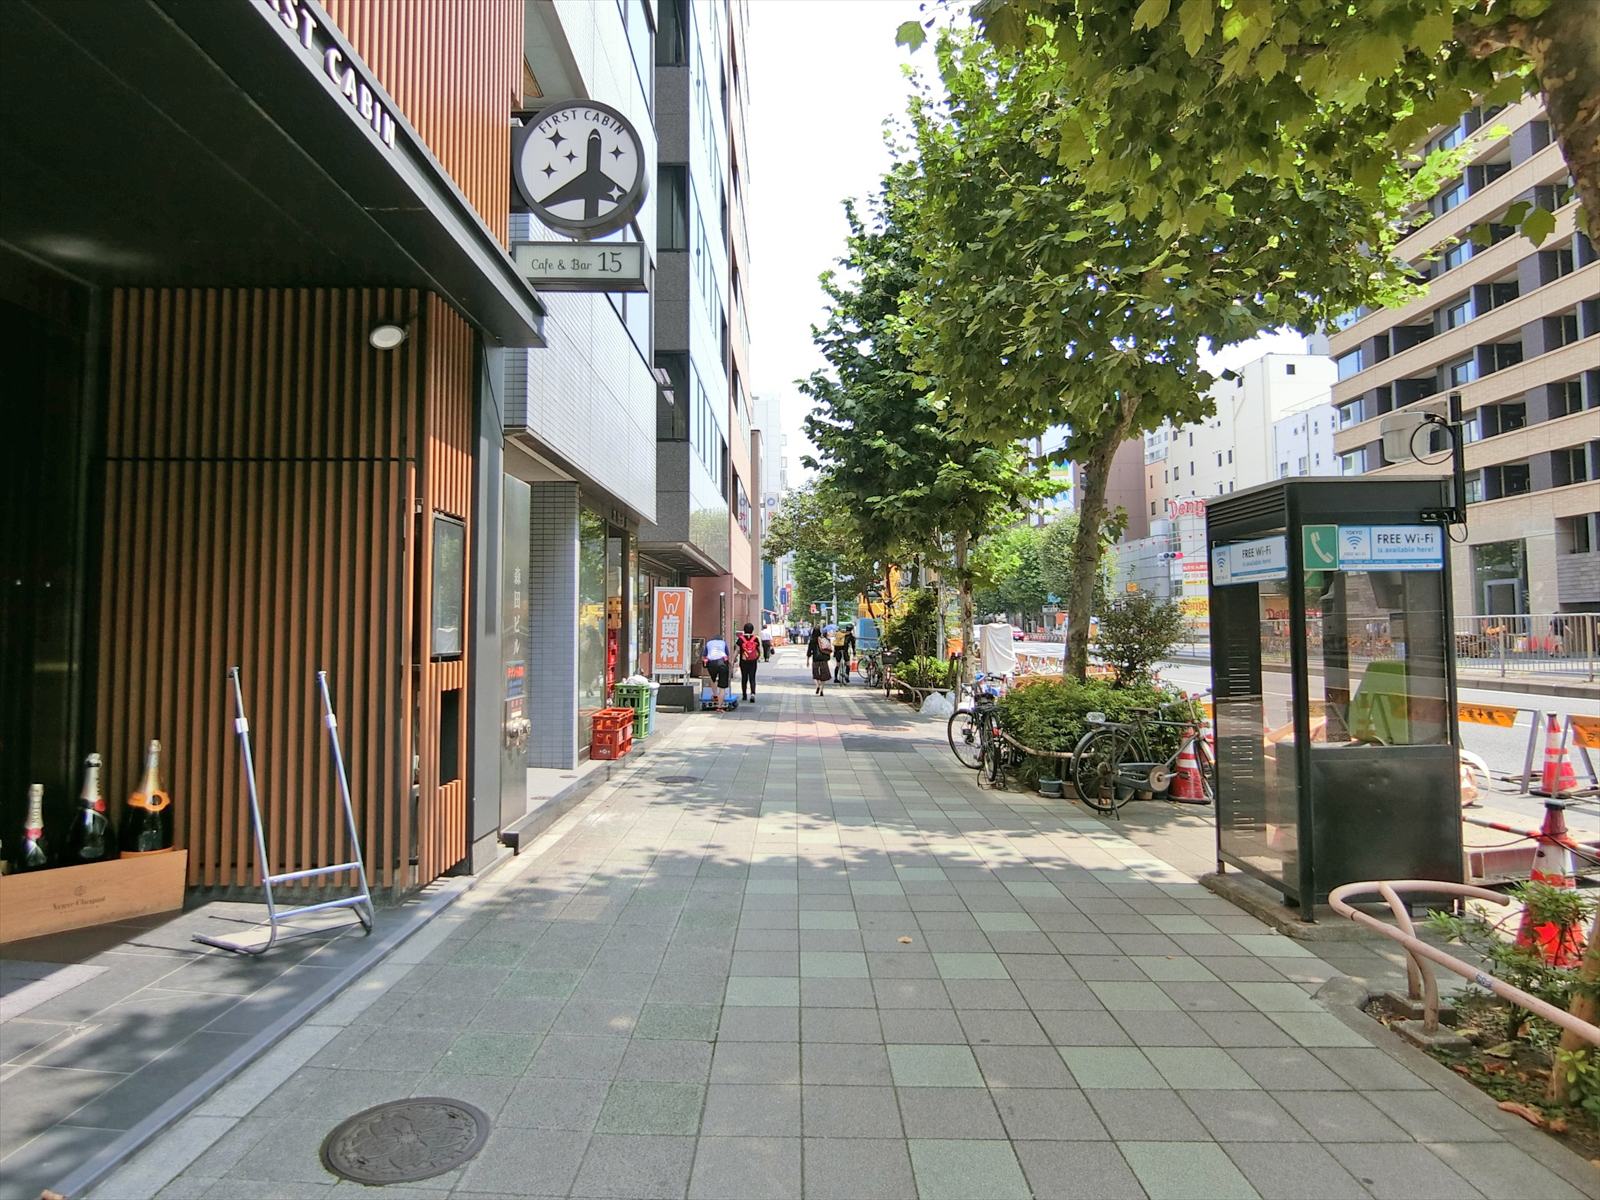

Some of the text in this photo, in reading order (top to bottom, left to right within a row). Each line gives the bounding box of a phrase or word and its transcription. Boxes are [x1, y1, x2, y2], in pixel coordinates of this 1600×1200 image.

[324, 47, 396, 150] CABIN
[538, 109, 626, 136] FIRST CABIN
[531, 251, 622, 274] Cafe & Bar 15
[1241, 545, 1272, 559] FREE Wi-Fi
[1377, 533, 1434, 544] FREE Wi-Fi
[513, 566, 521, 656] 森田ビル
[660, 614, 680, 663] 歯科
